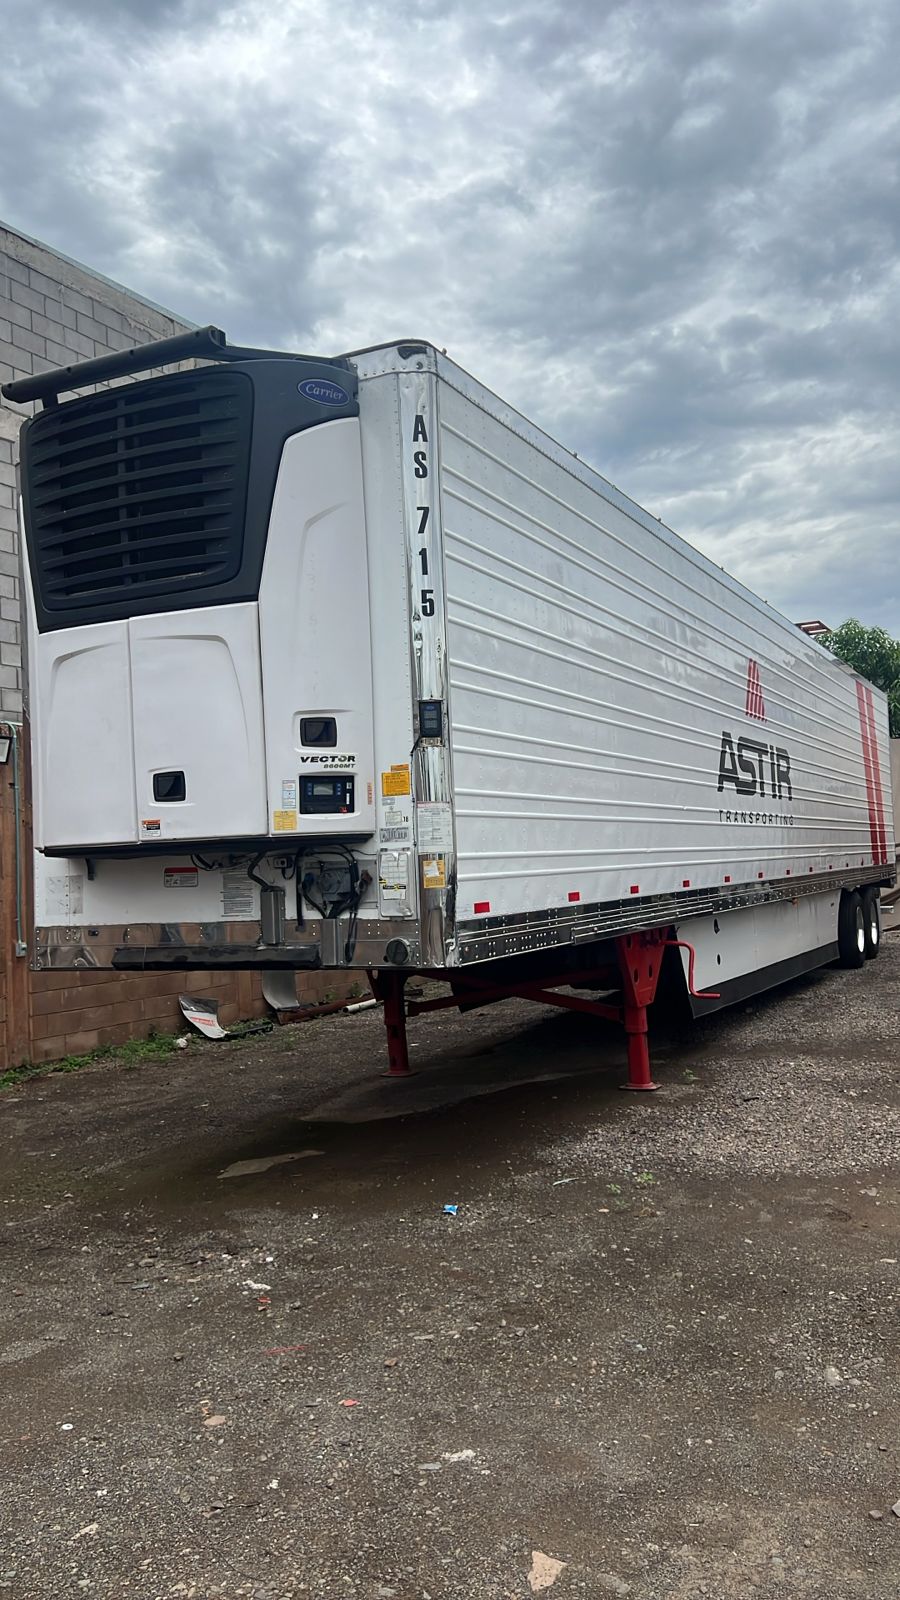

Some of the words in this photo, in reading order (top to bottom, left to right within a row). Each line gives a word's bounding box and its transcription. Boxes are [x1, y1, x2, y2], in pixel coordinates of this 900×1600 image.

[305, 383, 344, 400] Carrier
[412, 414, 429, 479] AS
[416, 506, 435, 617] 715
[300, 755, 356, 763] VECTOR
[717, 730, 793, 801] ASTIR
[719, 810, 794, 826] TRANSPORTING
